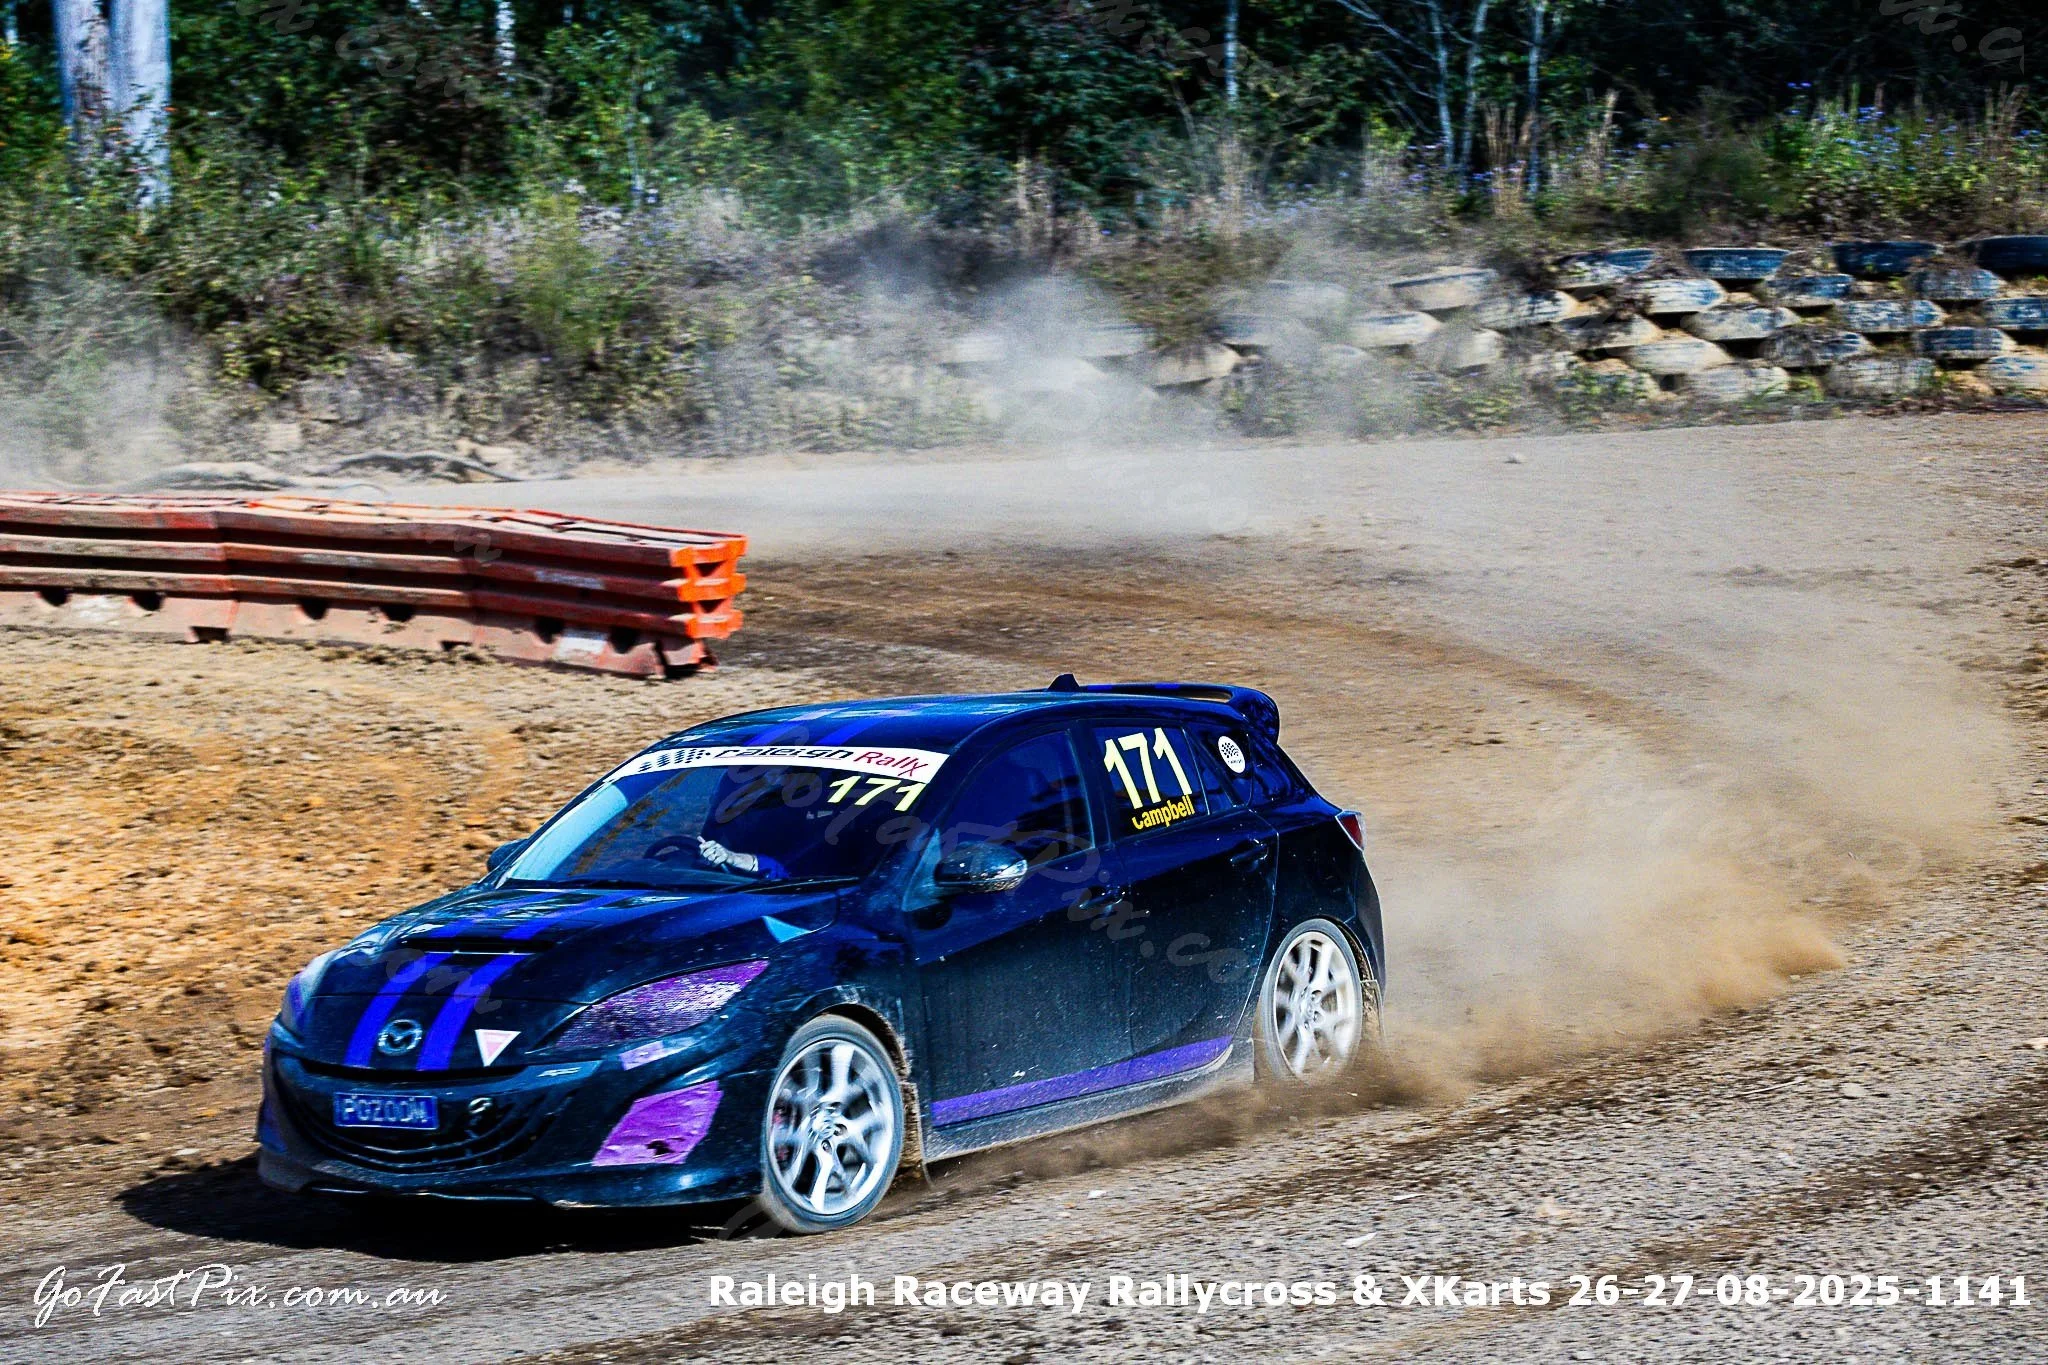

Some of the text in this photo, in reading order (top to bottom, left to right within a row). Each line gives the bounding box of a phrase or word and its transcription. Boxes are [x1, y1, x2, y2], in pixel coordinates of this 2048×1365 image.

[713, 747, 855, 759] raleigh
[1103, 727, 1193, 809] 171
[827, 775, 928, 812] 171
